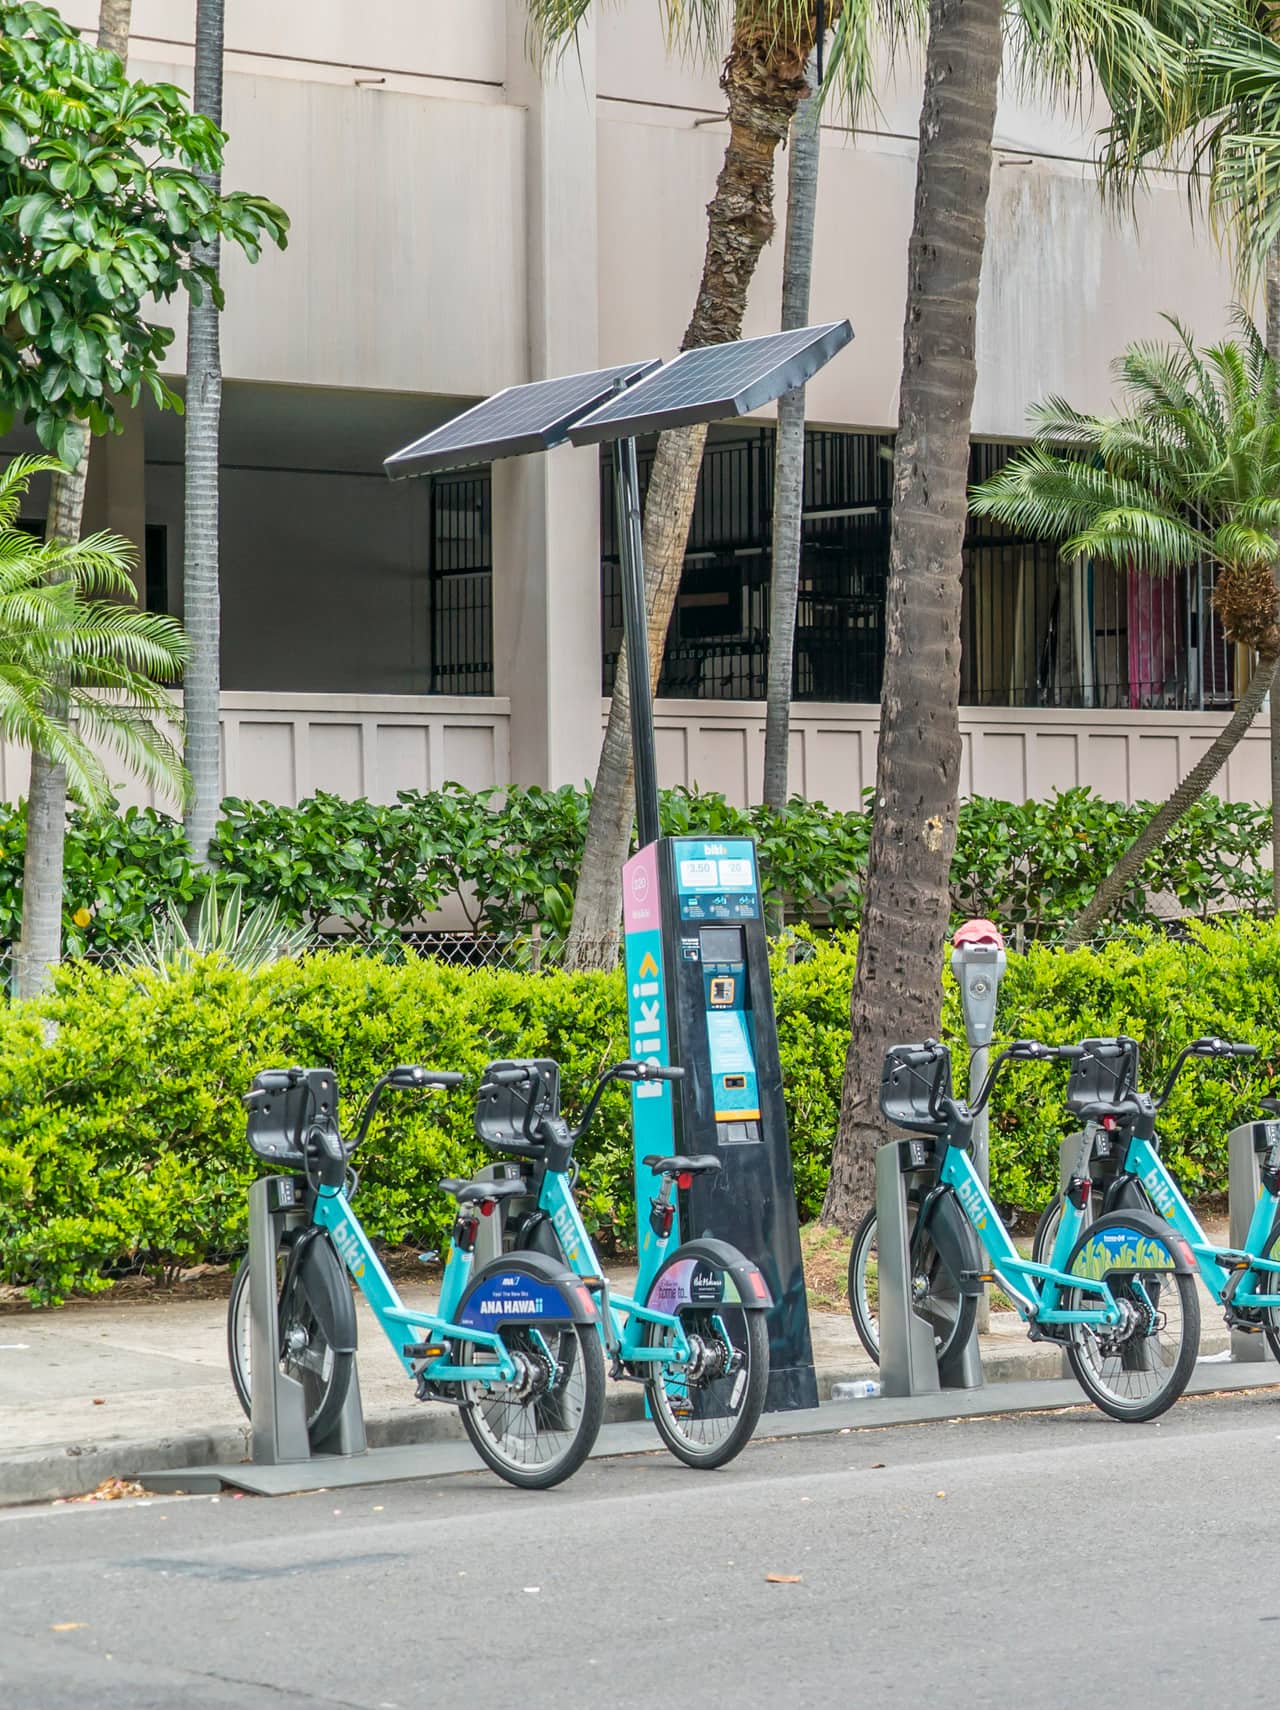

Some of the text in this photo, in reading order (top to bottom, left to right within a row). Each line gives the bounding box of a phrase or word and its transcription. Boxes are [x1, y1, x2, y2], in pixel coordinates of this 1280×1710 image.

[959, 1177, 987, 1223] biki
[1144, 1167, 1175, 1212] biki
[333, 1219, 365, 1271] biki
[554, 1204, 580, 1253] biki
[480, 1301, 503, 1315] ANA
